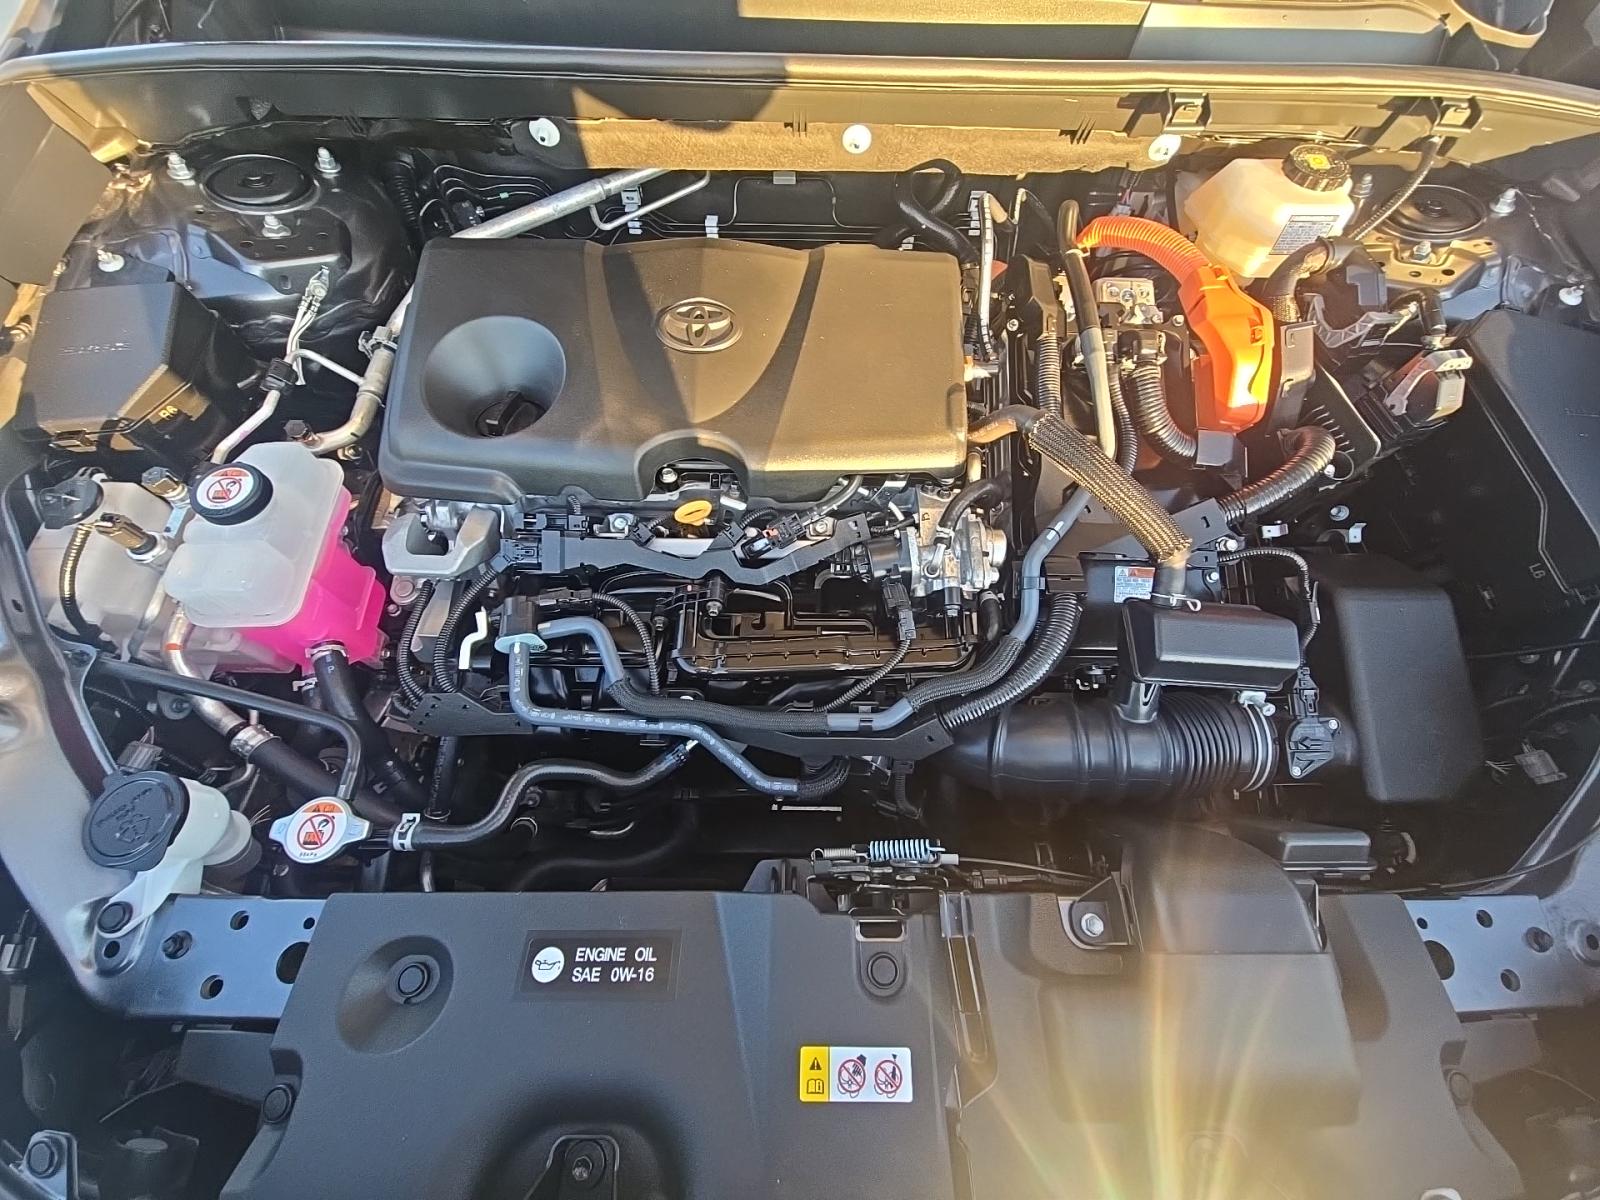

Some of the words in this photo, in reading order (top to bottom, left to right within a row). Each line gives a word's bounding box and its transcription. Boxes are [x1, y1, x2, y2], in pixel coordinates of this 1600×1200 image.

[575, 947, 627, 962] ENGINE
[634, 947, 657, 962] OIL
[571, 967, 601, 982] SAE
[610, 967, 655, 982] 0W-16
